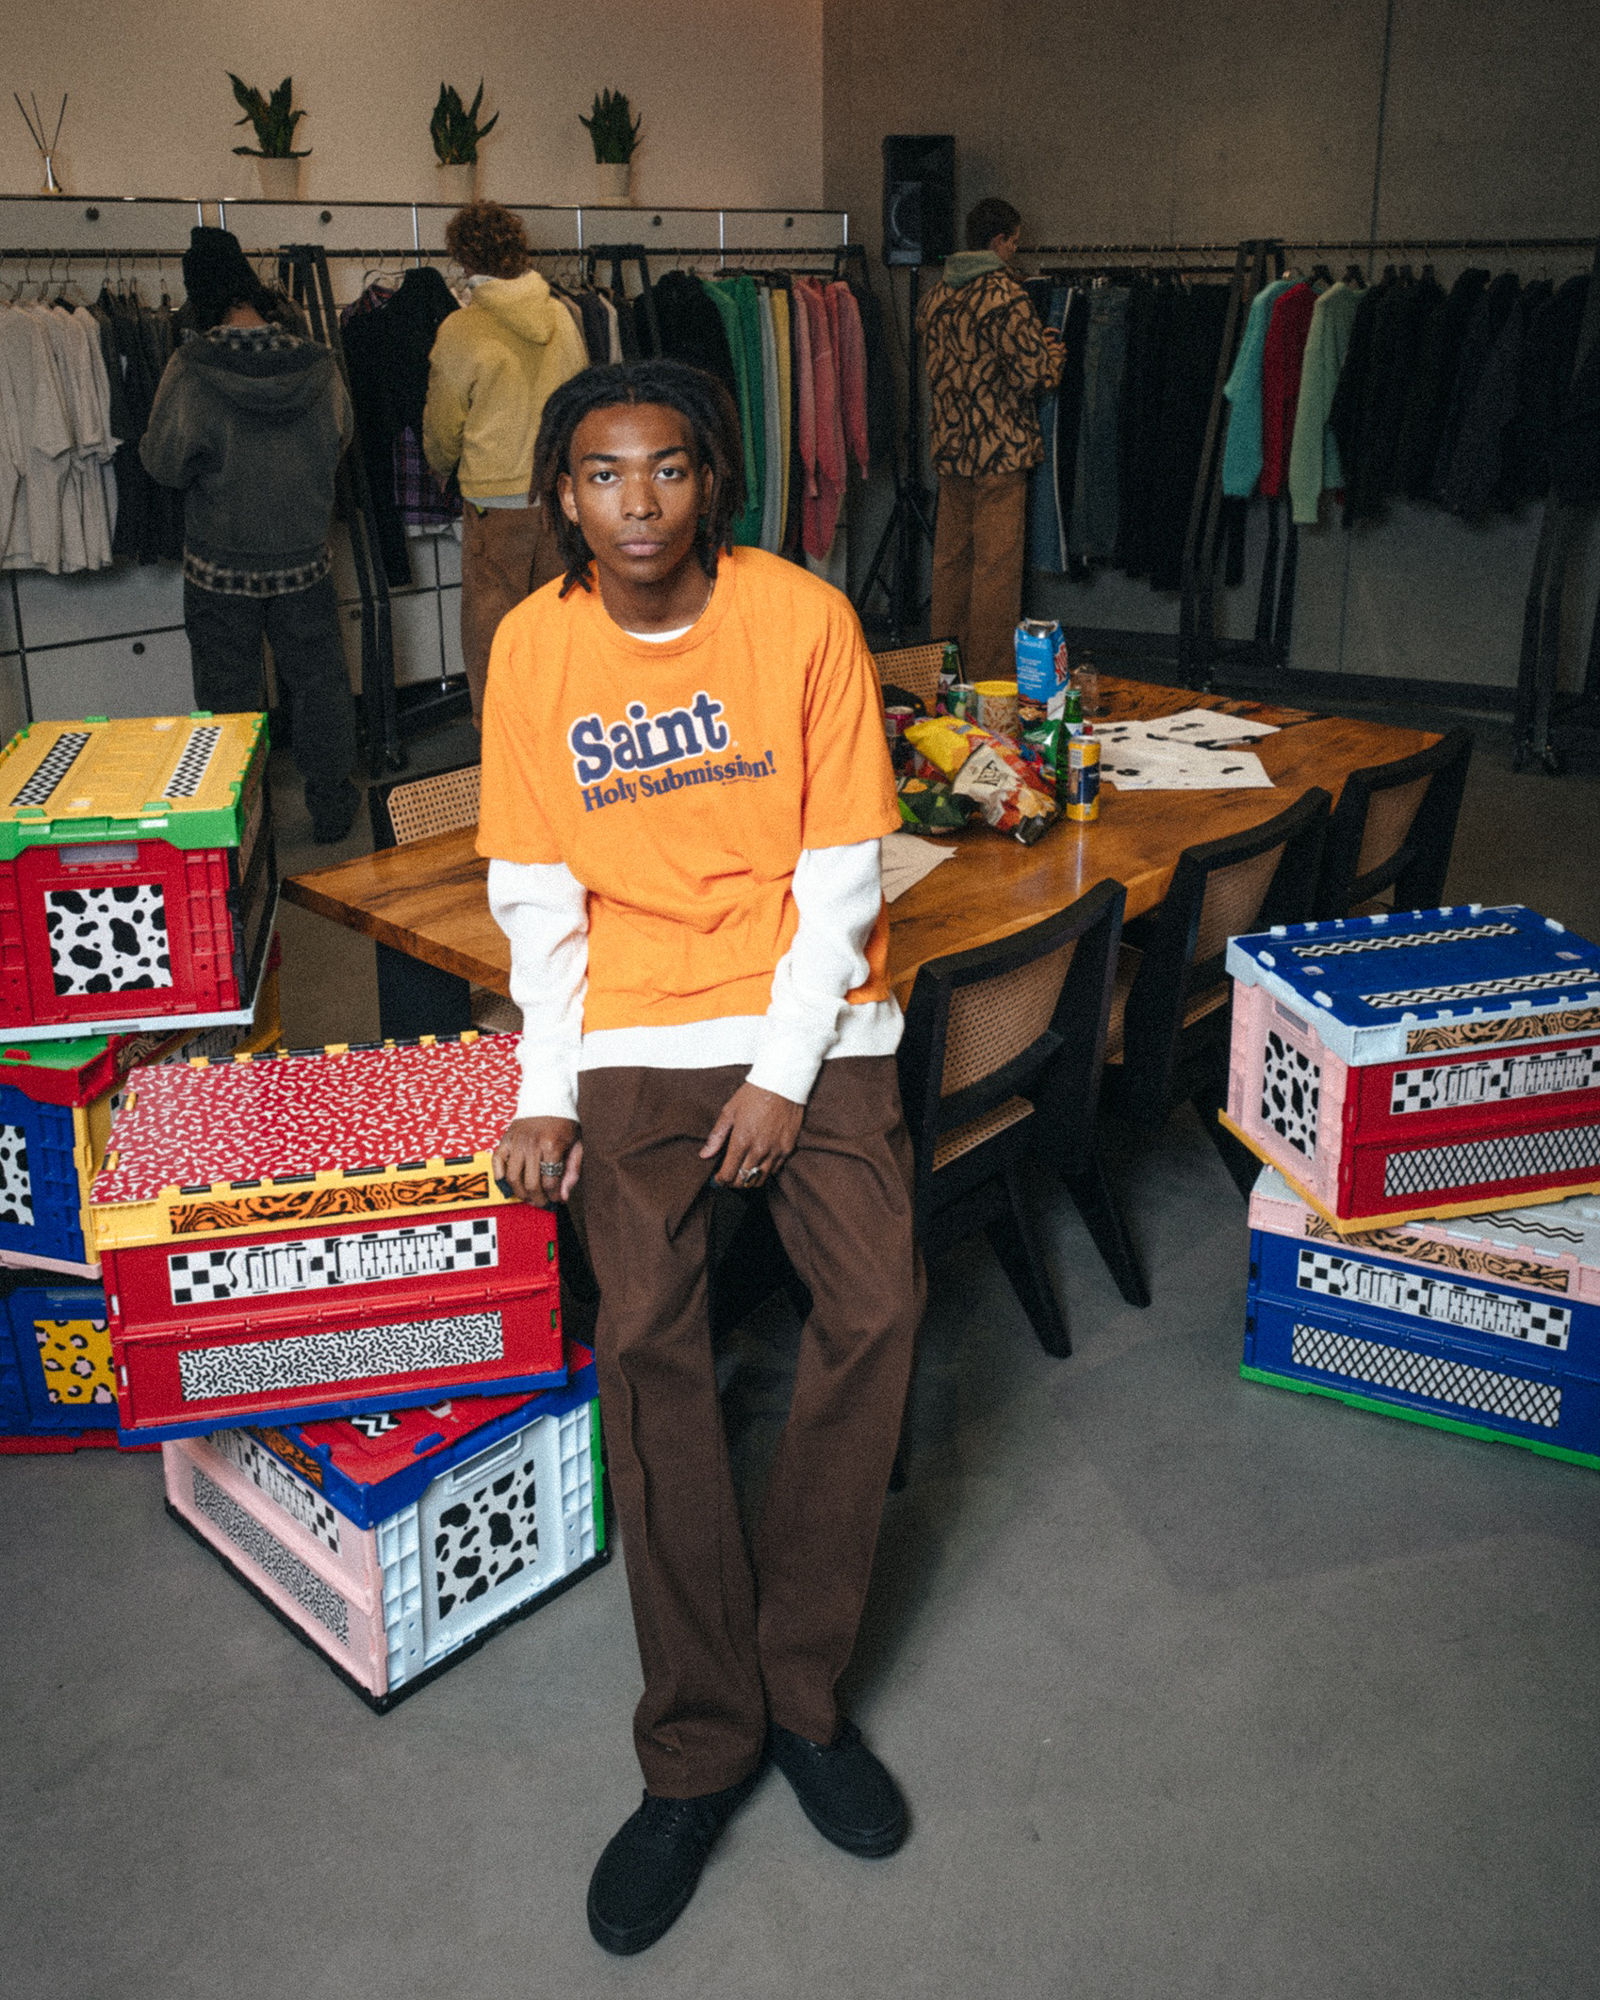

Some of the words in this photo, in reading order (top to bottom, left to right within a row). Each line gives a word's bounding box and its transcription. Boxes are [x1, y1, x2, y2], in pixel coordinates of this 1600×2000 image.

[569, 691, 729, 785] Saint
[580, 777, 637, 813] Holy
[640, 750, 777, 798] Submission!
[1432, 1065, 1492, 1104] SAINT
[227, 1247, 311, 1294] SAINT
[1340, 1262, 1409, 1306] SAINT
